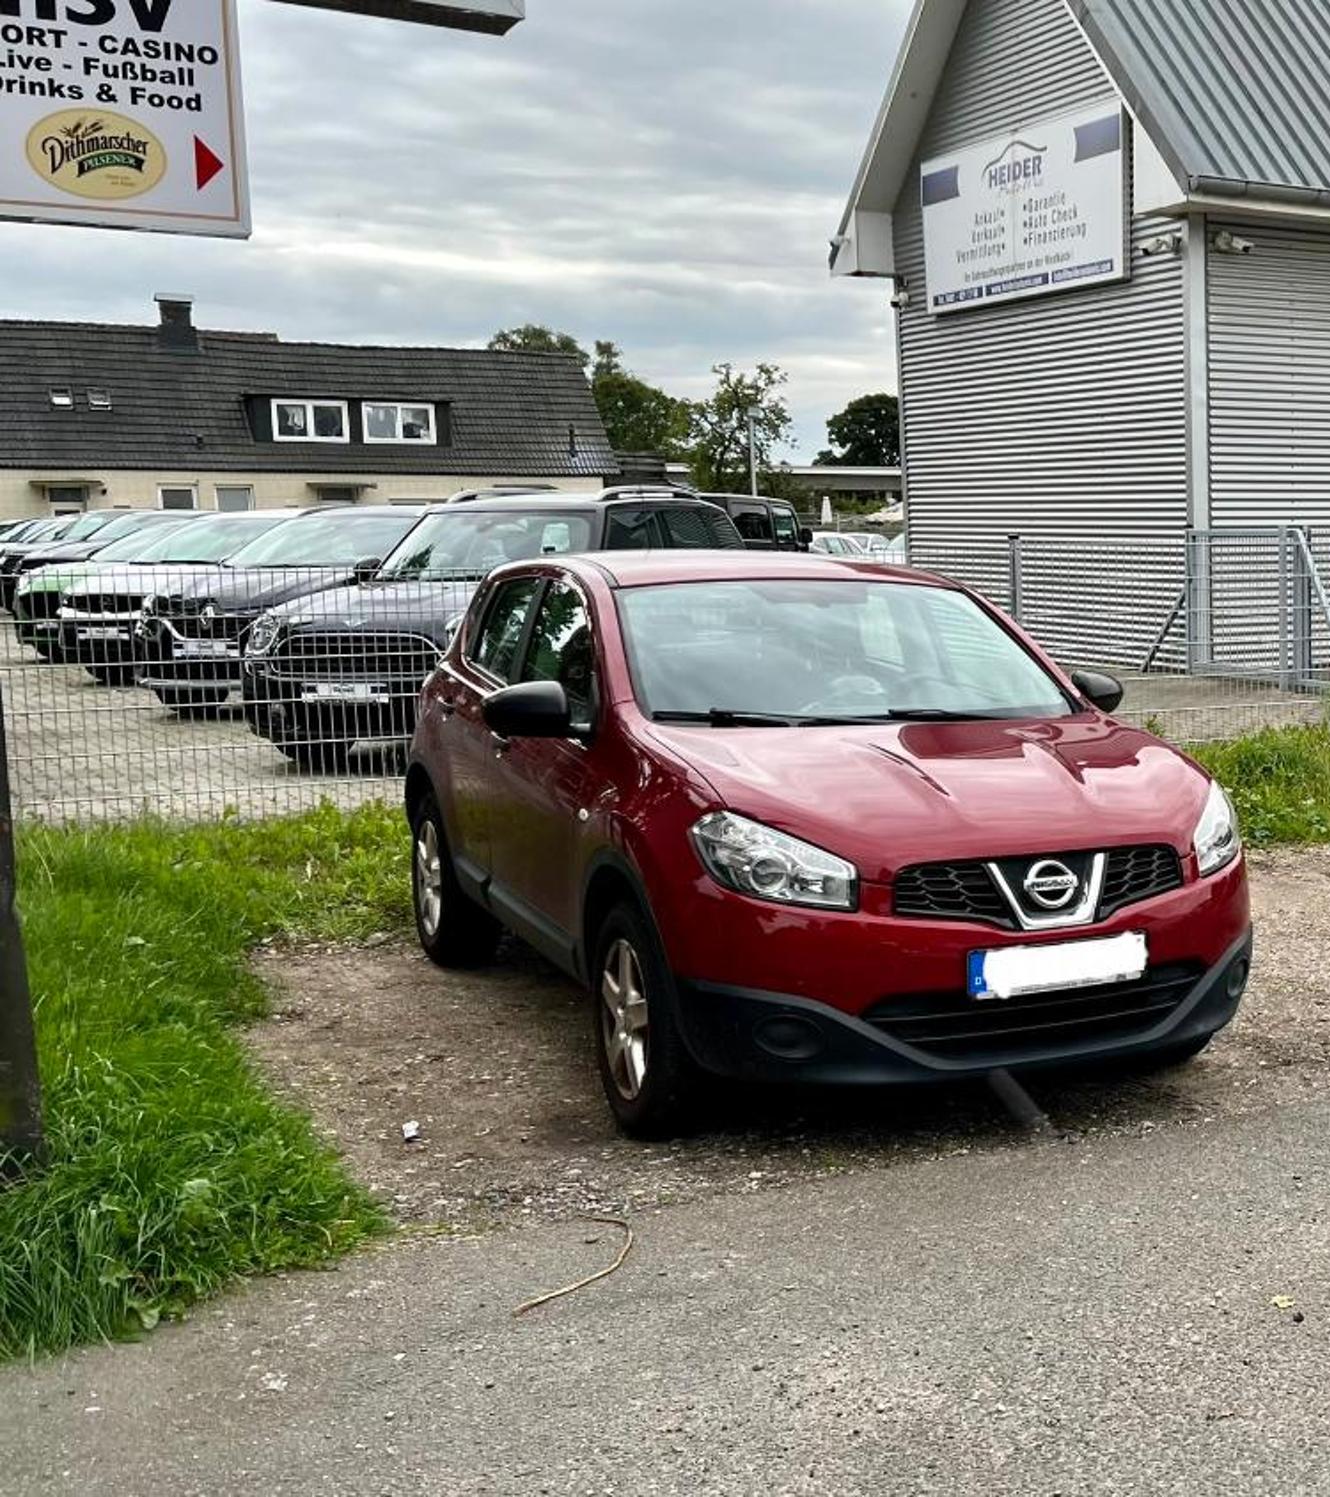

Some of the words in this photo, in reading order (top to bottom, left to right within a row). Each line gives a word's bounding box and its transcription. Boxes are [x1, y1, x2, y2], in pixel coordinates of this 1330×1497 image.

[98, 35, 218, 65] CASINO
[0, 49, 52, 71] ive
[83, 57, 194, 86] Fußball
[0, 74, 84, 100] rinks
[96, 83, 118, 103] &
[130, 86, 202, 112] Food
[41, 131, 149, 175] Dithmarscher
[83, 153, 137, 171] PILSENER
[989, 155, 1042, 188] HEIDER
[1028, 223, 1086, 247] Finanzierung
